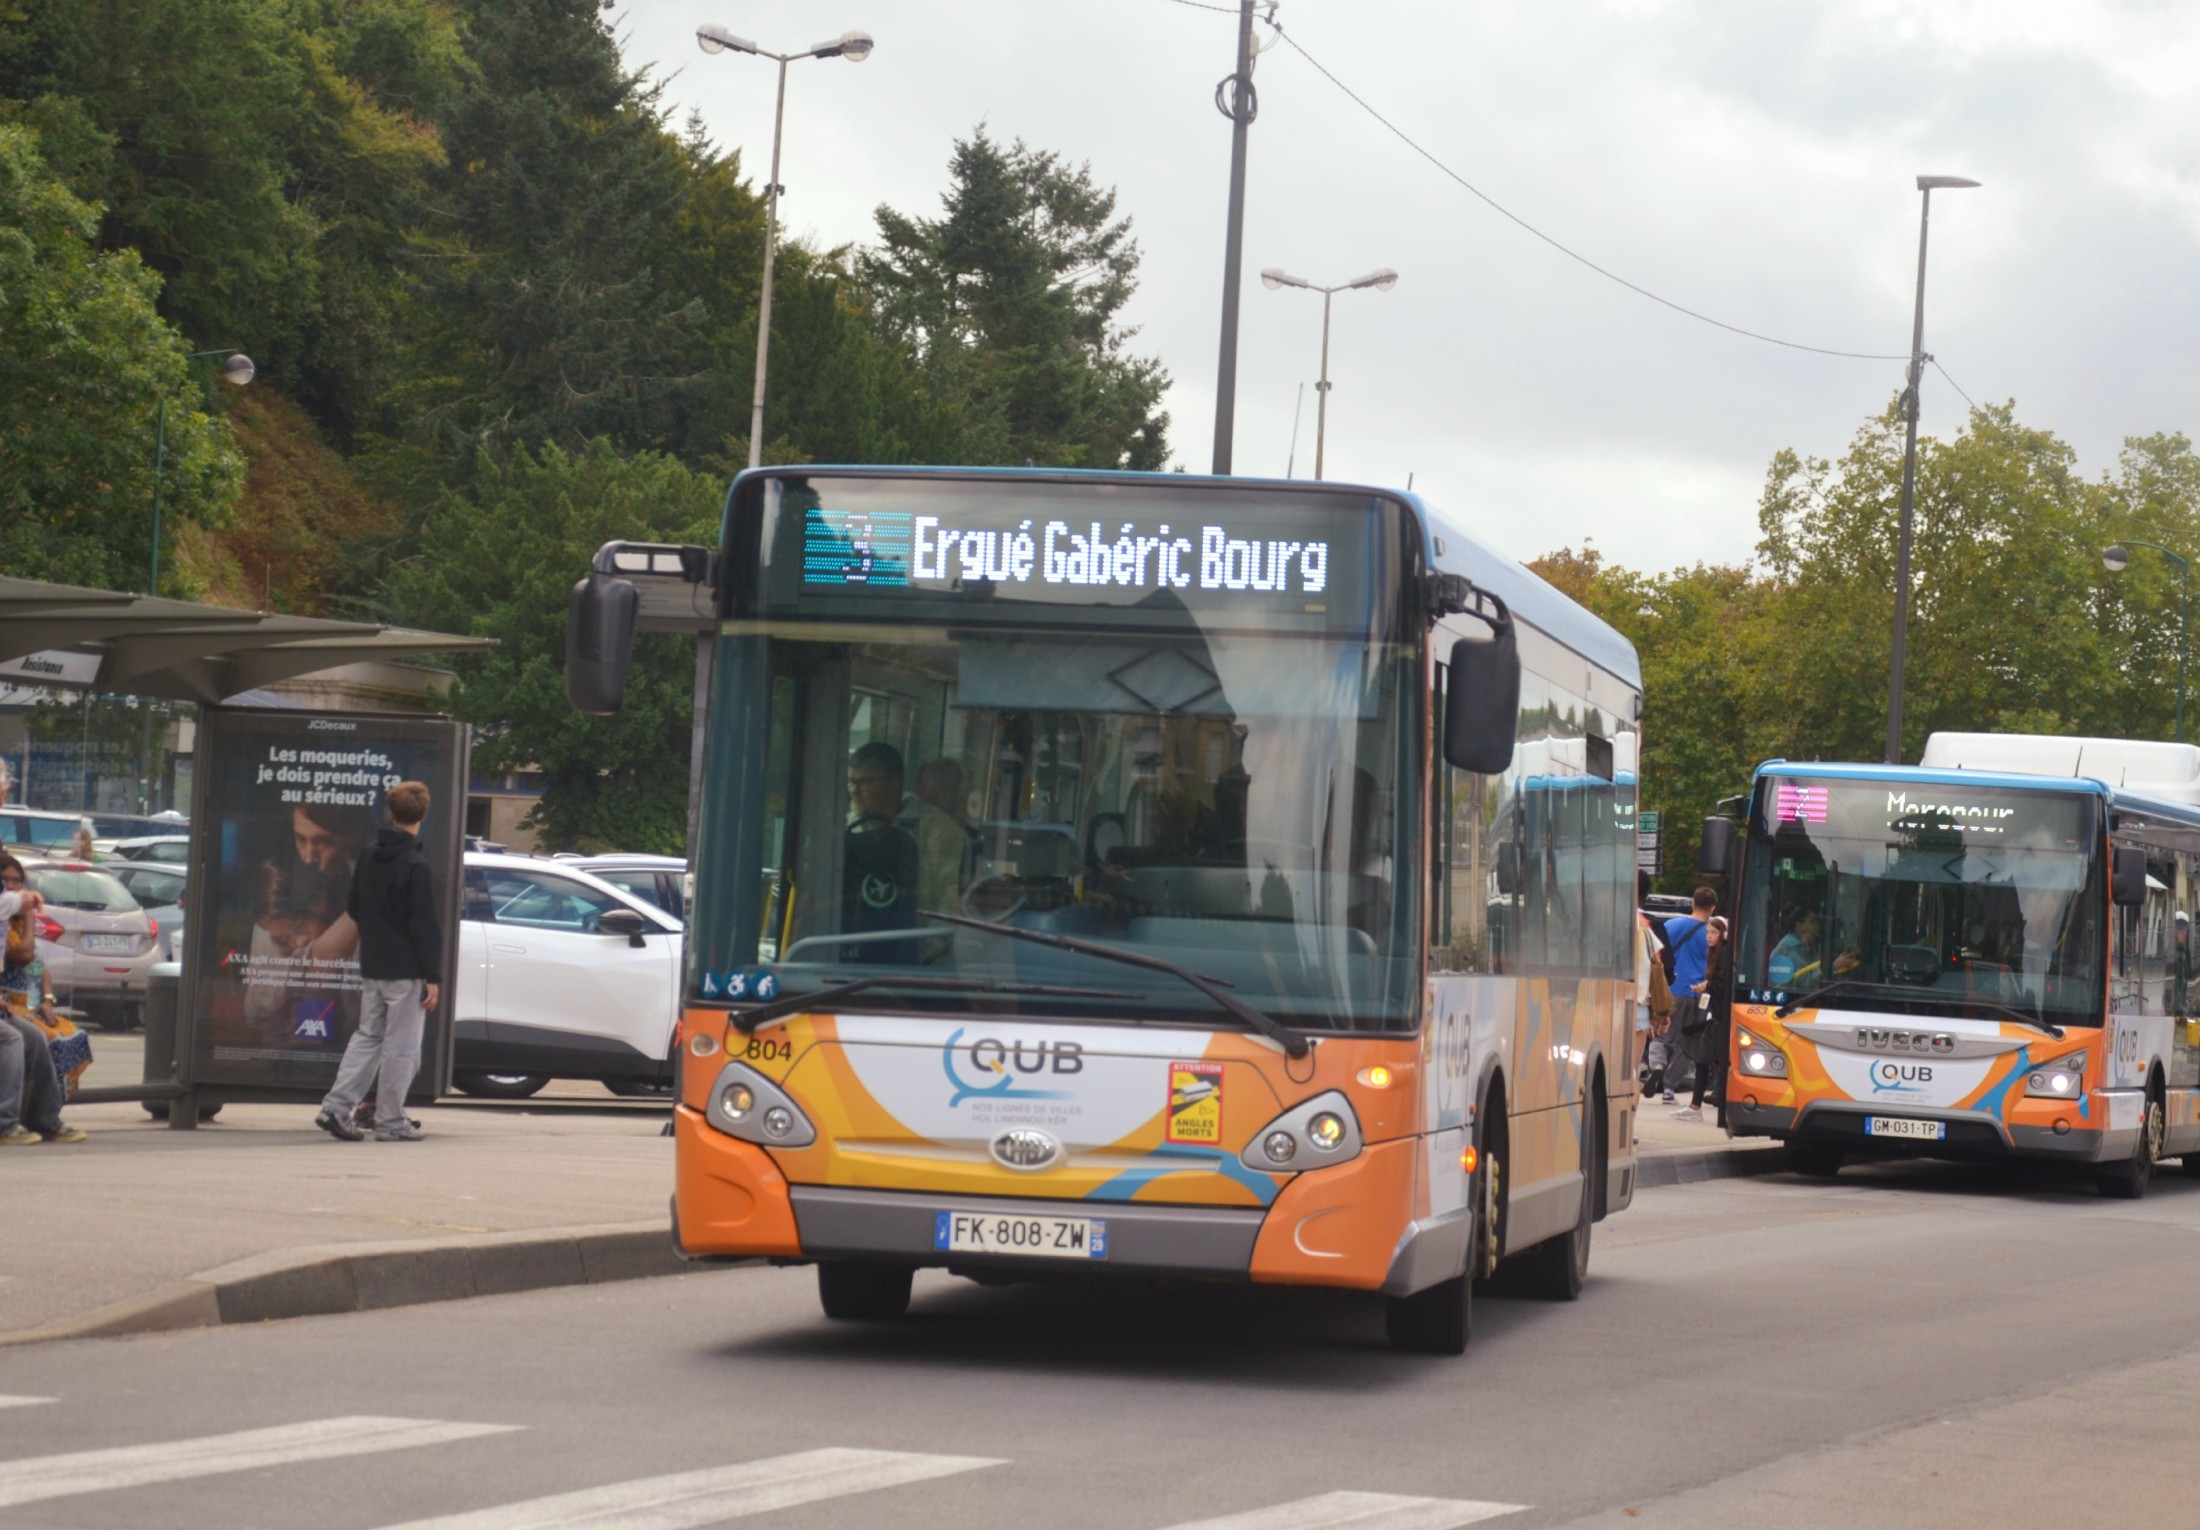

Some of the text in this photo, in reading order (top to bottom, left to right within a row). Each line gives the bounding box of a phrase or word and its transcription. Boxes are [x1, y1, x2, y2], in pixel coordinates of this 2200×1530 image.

[914, 517, 1327, 591] Ergué Gabéric Bourg
[307, 720, 357, 731] JCDecaux
[269, 746, 393, 770] Les moqueries,
[256, 764, 274, 784] je
[276, 766, 311, 783] dois
[313, 769, 380, 787] prendre
[281, 789, 302, 802] au
[227, 953, 248, 963] AXA
[269, 957, 301, 966] contre
[302, 956, 312, 967] le
[1747, 1006, 1768, 1016] 653
[295, 1019, 327, 1036] AXA
[1858, 1028, 1954, 1053] IVECO
[2120, 1030, 2138, 1063] QUB
[747, 1039, 791, 1061] 804
[970, 1037, 1084, 1075] QUB
[1173, 1063, 1223, 1073] ATTENTION
[1882, 1064, 1933, 1082] QUB
[972, 1103, 1082, 1115] NOS LIGNES DE VILLES
[1175, 1119, 1214, 1129] ANGLES
[1177, 1128, 1211, 1137] MORTS
[1874, 1119, 1936, 1135] GM-031-TP
[954, 1217, 1084, 1249] FK-808-ZW
